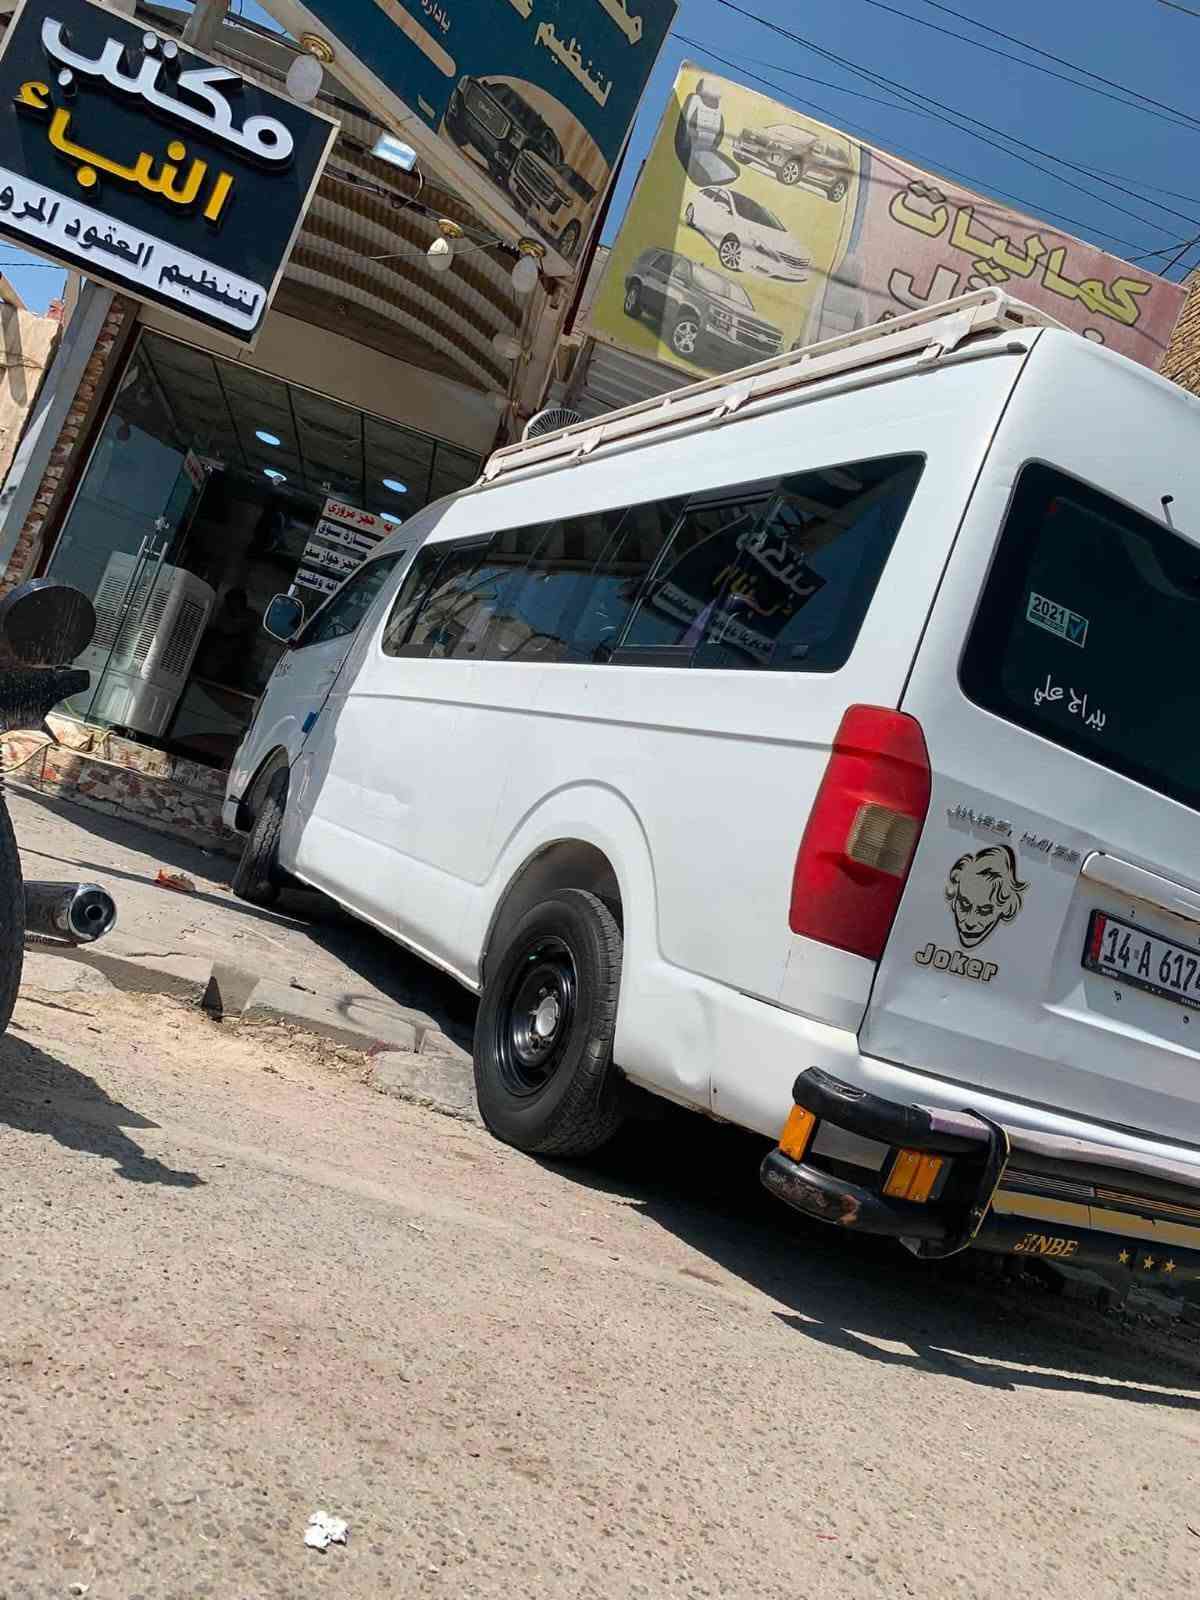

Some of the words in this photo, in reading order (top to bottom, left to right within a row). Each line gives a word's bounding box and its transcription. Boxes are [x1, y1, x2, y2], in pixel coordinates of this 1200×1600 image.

[41, 17, 293, 160] مكتب
[534, 22, 612, 106] لتنظيم
[64, 218, 154, 268] العقود
[889, 179, 1151, 326] كماليات
[158, 263, 260, 316] لتنظيم
[1032, 596, 1065, 625] 2021
[1034, 675, 1064, 706] علي
[1103, 927, 1131, 970] 14
[1138, 941, 1152, 978] A
